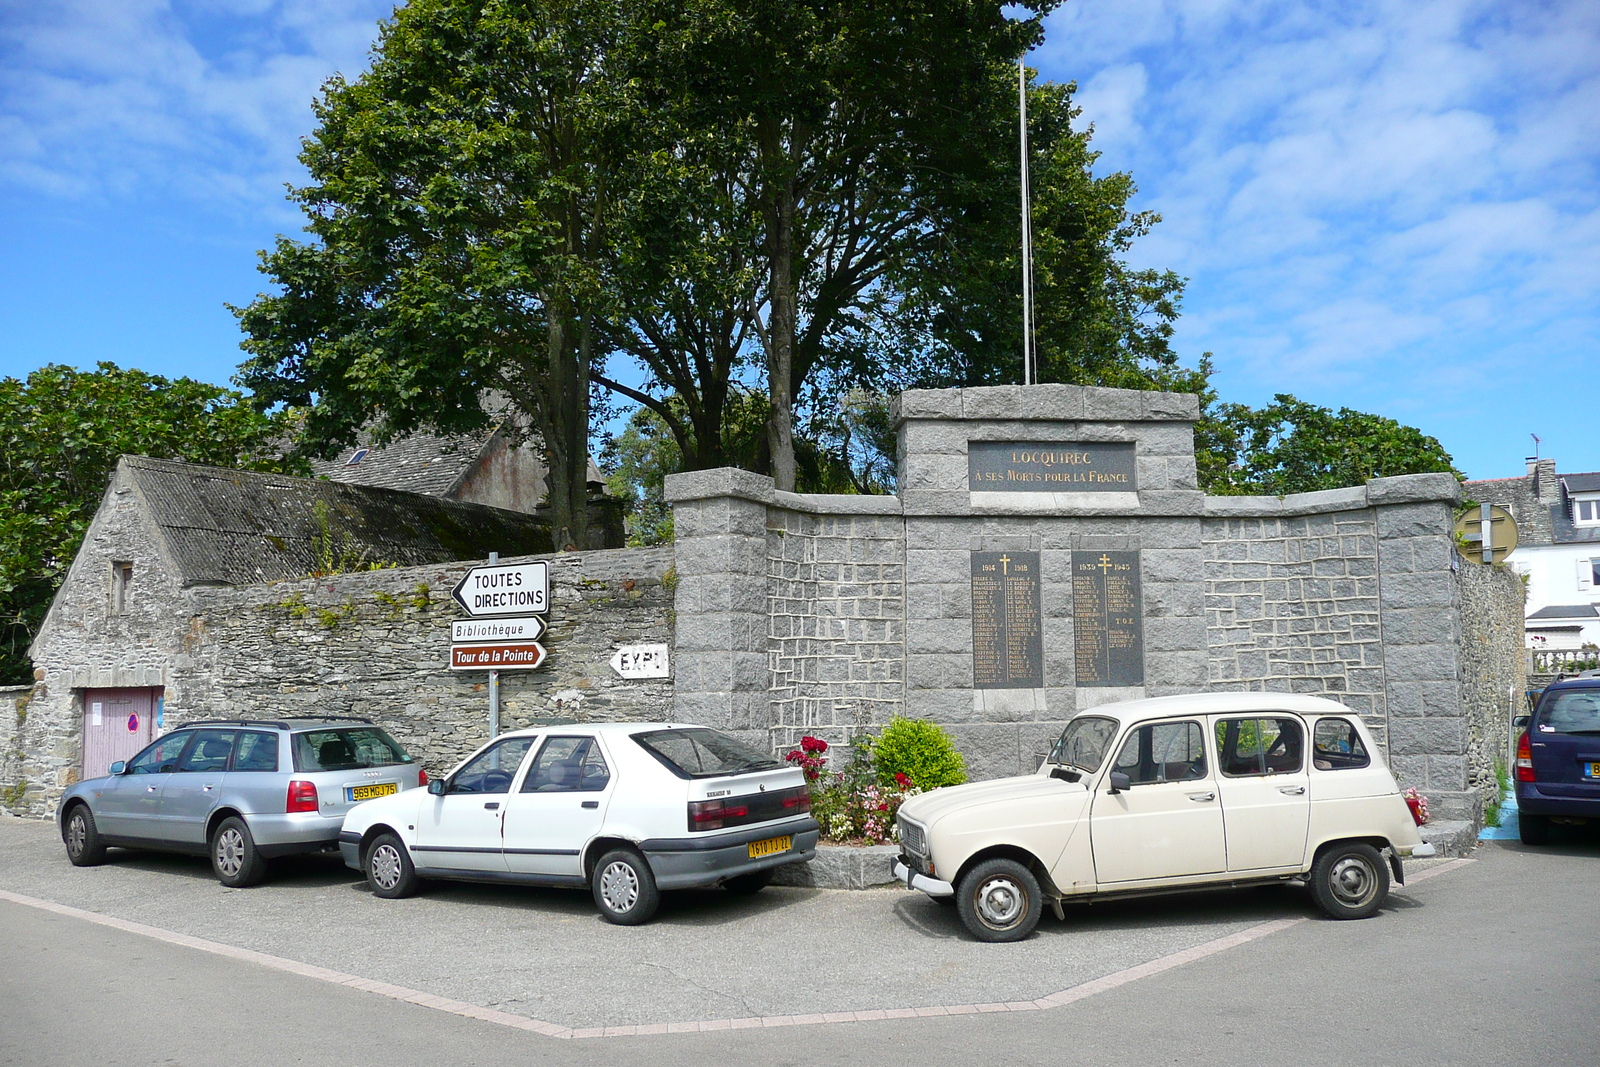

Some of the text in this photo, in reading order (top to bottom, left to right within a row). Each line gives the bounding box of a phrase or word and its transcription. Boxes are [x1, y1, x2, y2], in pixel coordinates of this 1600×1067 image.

[1012, 452, 1092, 466] LOCQUIREC
[986, 471, 1004, 480] SES
[1045, 473, 1070, 482] POUR
[1073, 473, 1086, 482] LA
[1088, 470, 1128, 482] FRANCE
[474, 572, 522, 589] TOUTES
[474, 590, 543, 608] DIRECTIONS
[456, 622, 523, 638] Bibliothèque
[456, 649, 534, 663] Tour de la Pointe
[354, 785, 395, 798] 969 MGJ 75
[752, 837, 788, 855] 1610 TJ 22
